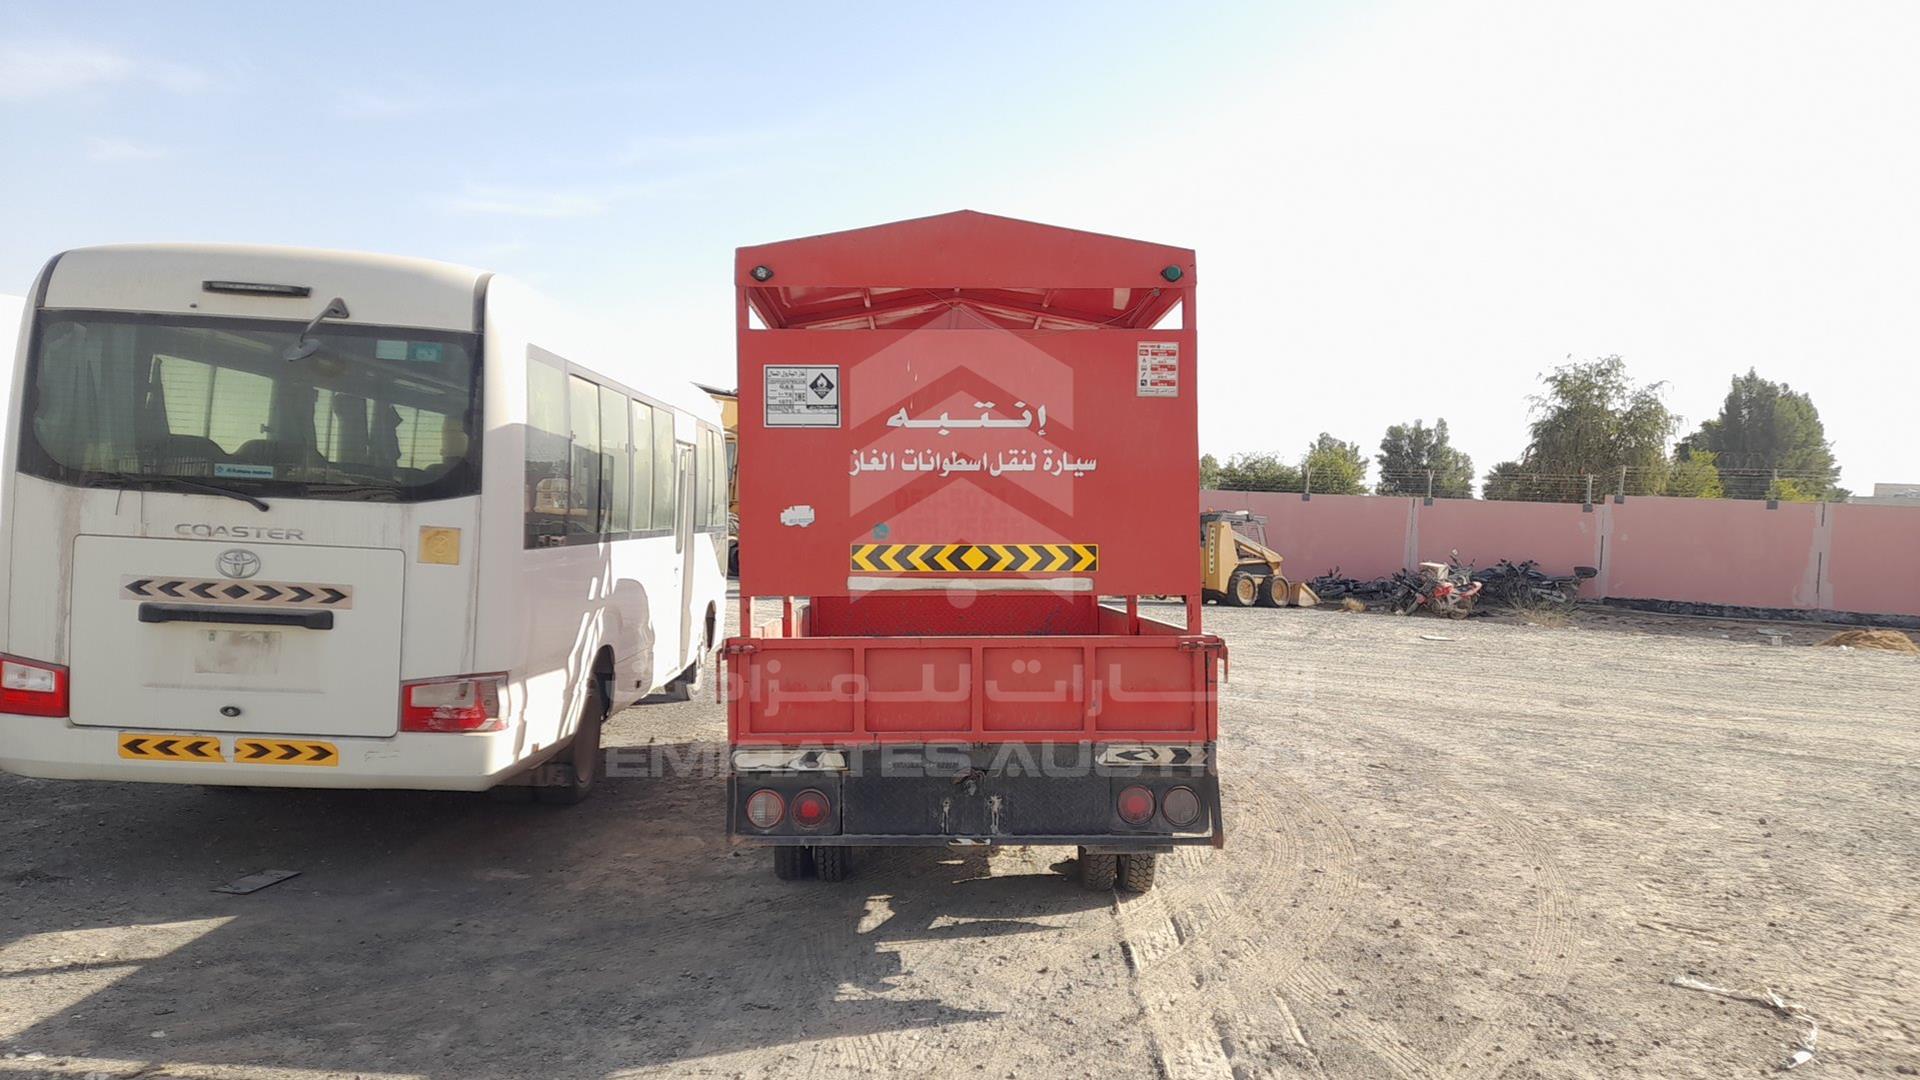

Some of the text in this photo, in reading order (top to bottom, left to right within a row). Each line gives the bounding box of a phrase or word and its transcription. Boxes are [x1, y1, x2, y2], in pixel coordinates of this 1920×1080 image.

[848, 449, 1096, 477] سيارة لنقل اسطوانات الغاز
[174, 523, 304, 540] COASTER
